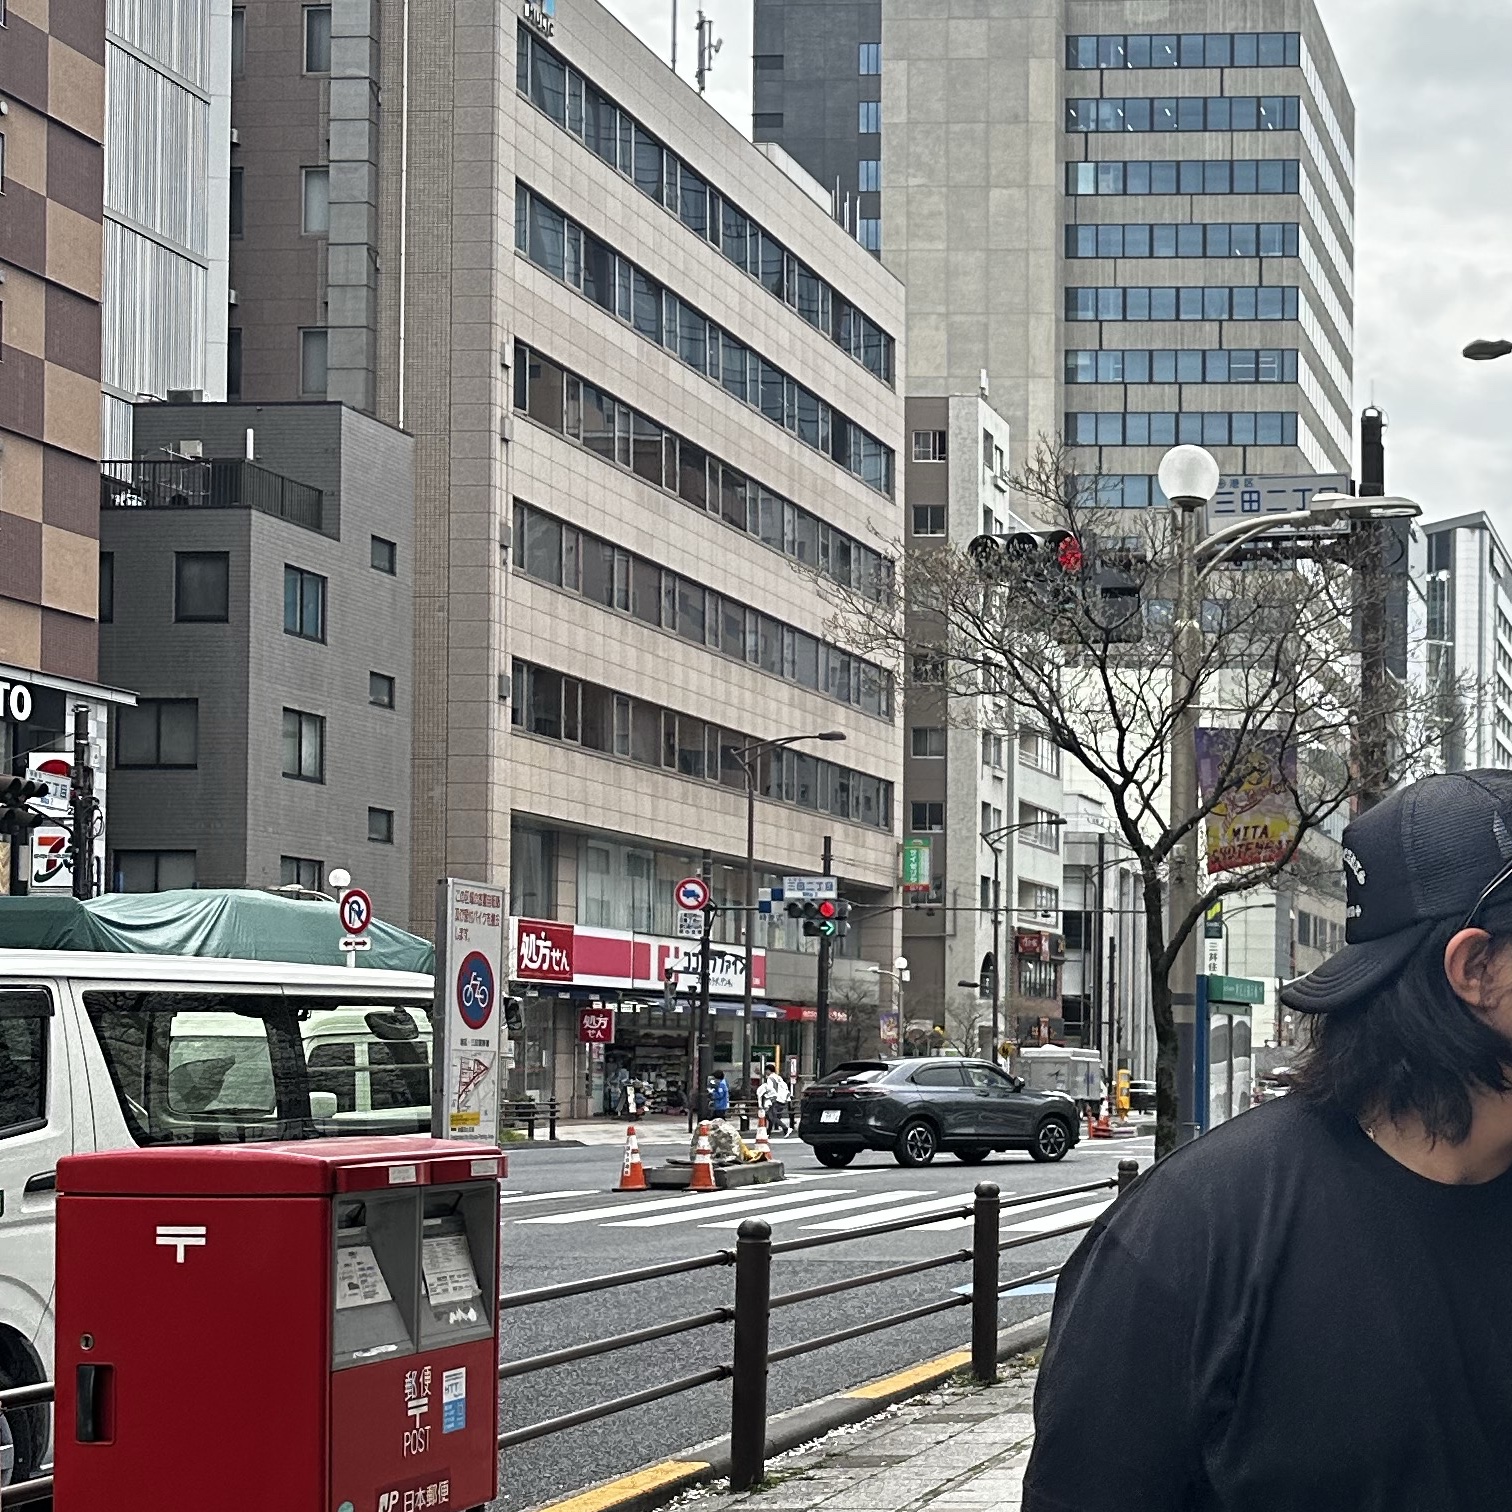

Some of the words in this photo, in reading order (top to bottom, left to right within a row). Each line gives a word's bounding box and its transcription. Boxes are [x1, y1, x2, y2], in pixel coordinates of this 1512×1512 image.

[1232, 824, 1269, 840] MITA
[519, 931, 571, 973] 処方せん
[1208, 942, 1219, 975] 三井住
[583, 1014, 609, 1028] 処方
[587, 1029, 604, 1039] せん
[404, 1365, 432, 1402] 郵便
[403, 1425, 432, 1459] POST
